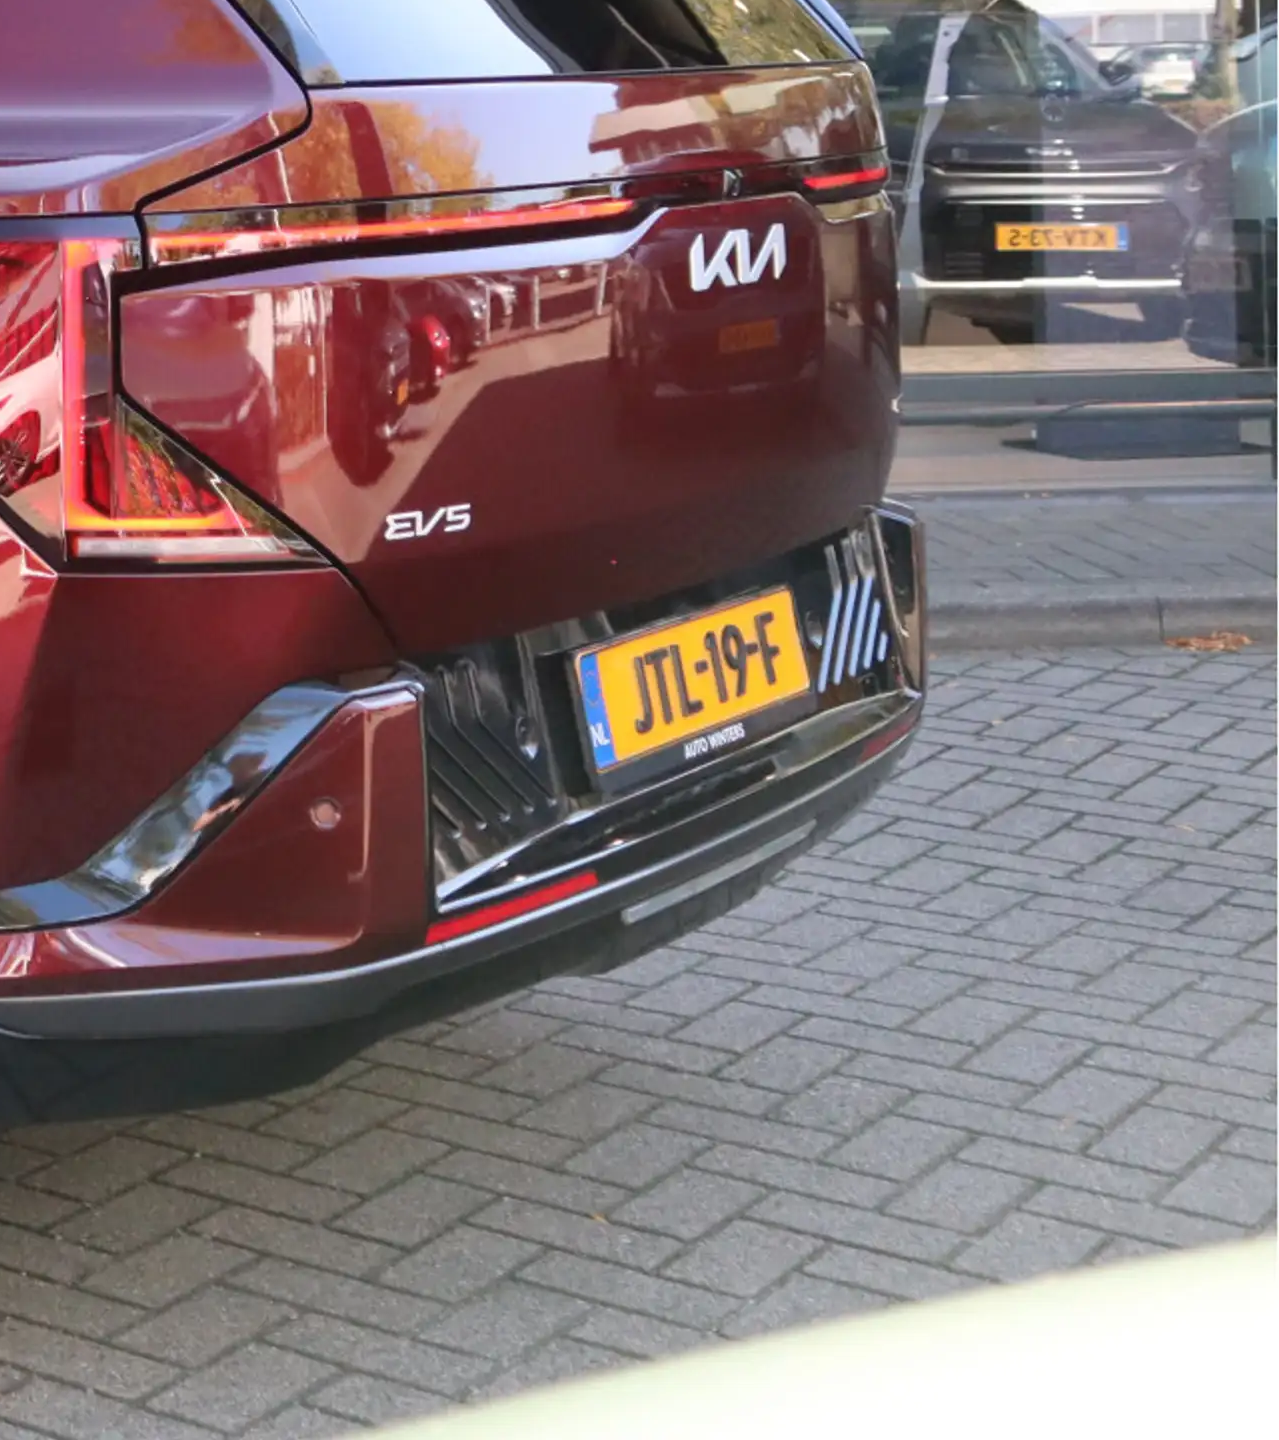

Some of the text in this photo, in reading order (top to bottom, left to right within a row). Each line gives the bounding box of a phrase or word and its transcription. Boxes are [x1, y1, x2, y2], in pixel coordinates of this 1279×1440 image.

[689, 222, 787, 292] KIA
[384, 503, 471, 541] EV5
[633, 611, 780, 735] JTL-19-F
[590, 722, 611, 748] NL
[684, 721, 746, 760] AUTO WINTERS
